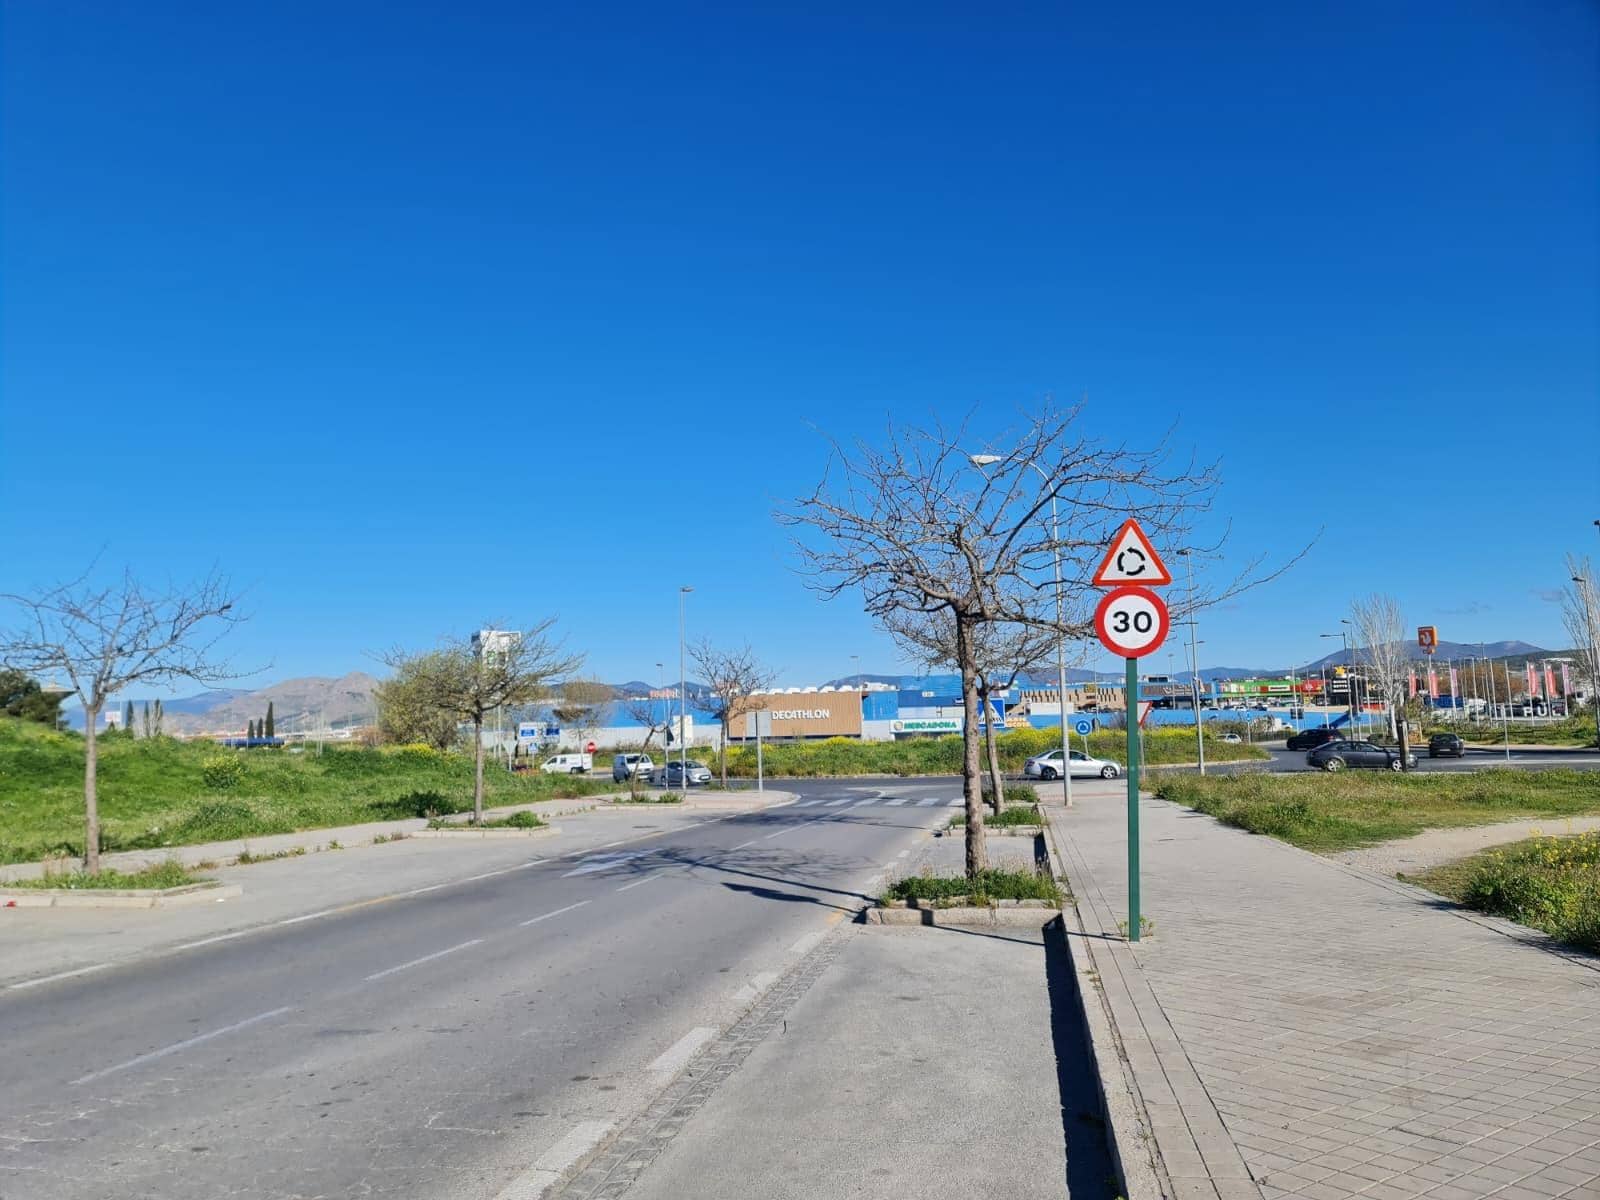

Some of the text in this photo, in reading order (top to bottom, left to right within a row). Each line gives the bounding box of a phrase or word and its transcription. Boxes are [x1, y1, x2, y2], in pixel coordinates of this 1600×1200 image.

[1113, 611, 1152, 633] 30
[772, 709, 830, 720] DECATHLON
[904, 721, 957, 730] MERCADONA
